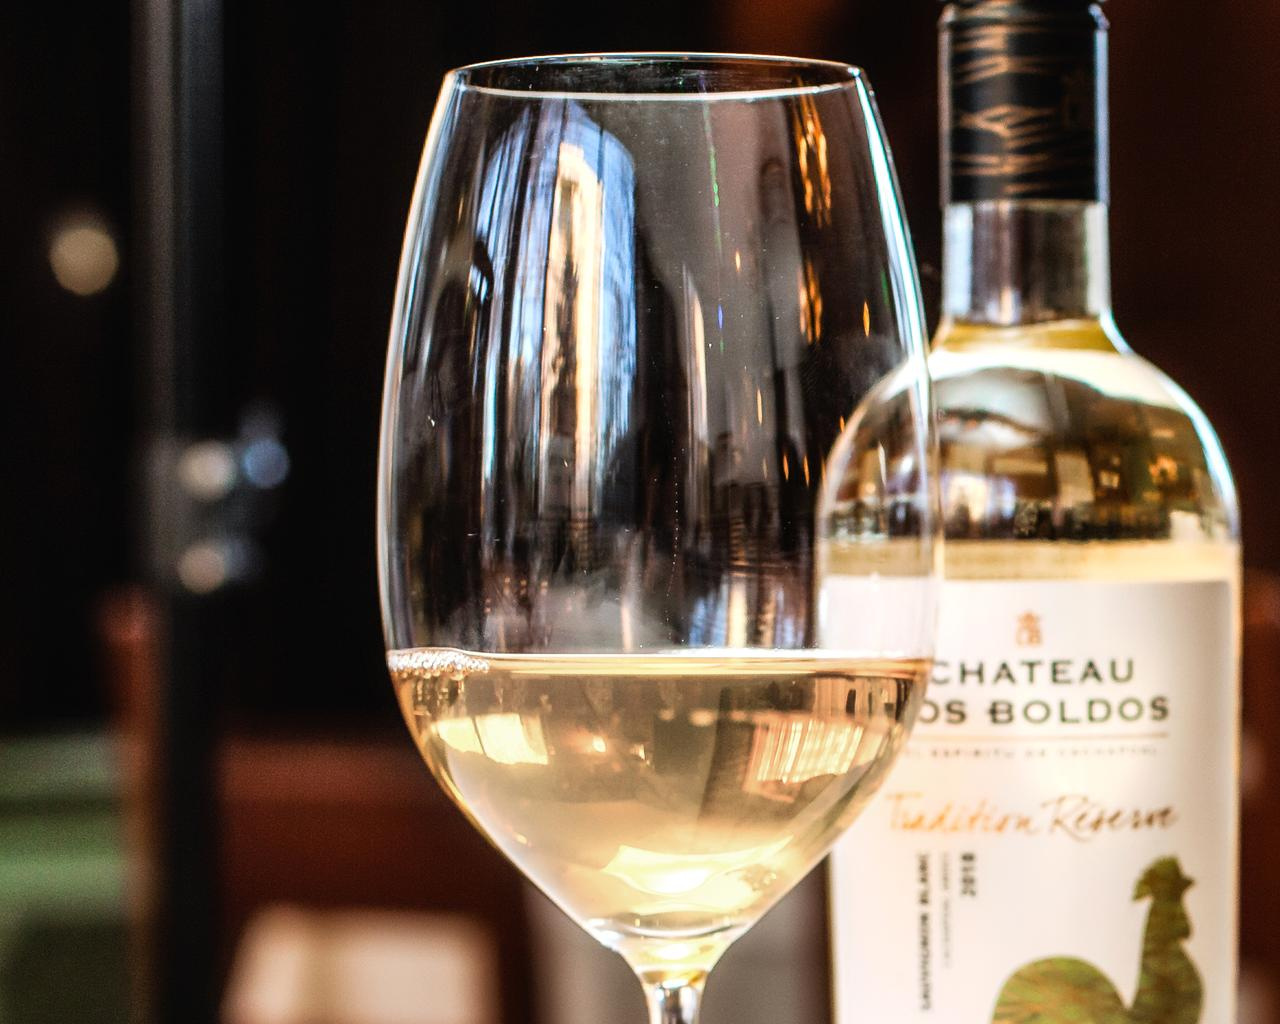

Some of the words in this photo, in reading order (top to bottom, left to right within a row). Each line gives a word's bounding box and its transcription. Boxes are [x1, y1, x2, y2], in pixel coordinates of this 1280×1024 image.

[932, 658, 1135, 686] CHATEAU
[918, 698, 968, 725] OS
[988, 696, 1170, 726] BOLDOS
[884, 791, 1038, 832] Tradition
